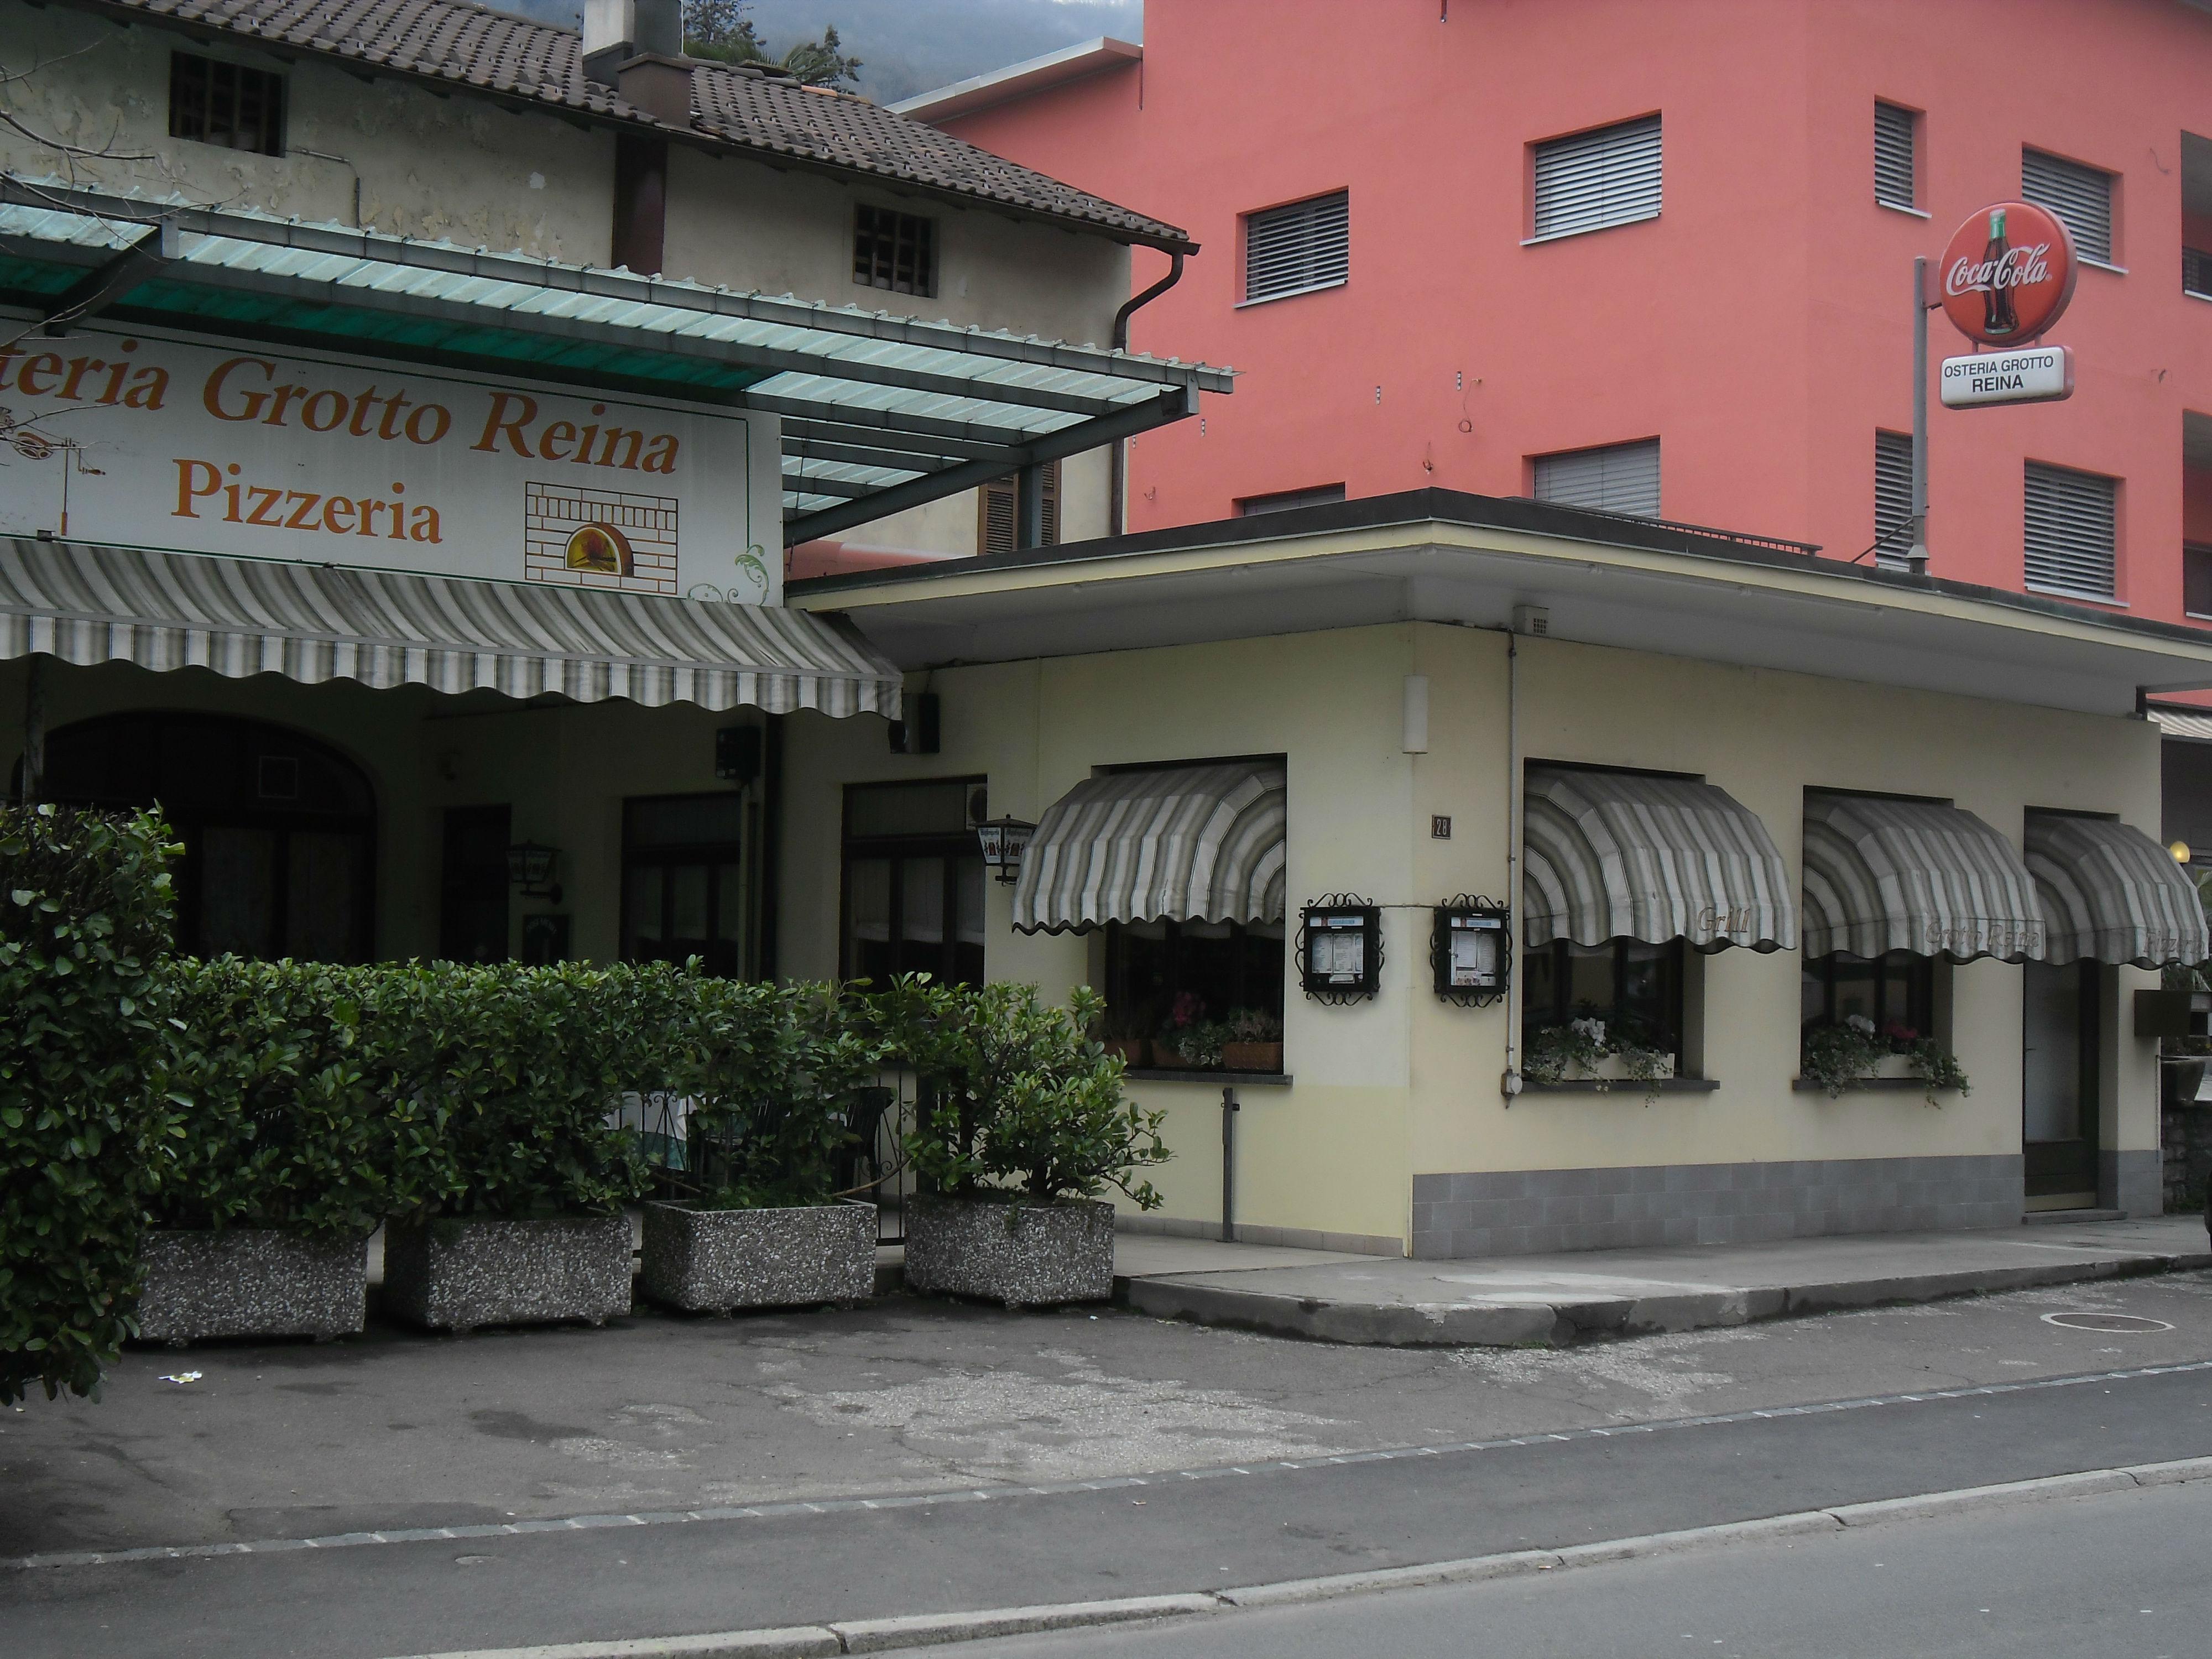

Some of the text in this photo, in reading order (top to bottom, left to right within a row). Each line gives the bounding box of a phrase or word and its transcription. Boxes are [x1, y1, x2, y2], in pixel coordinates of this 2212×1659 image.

[1946, 243, 2051, 296] Coca-Cola
[1944, 356, 2054, 378] OSTERIA GROTTO
[1972, 374, 2024, 393] REINA
[203, 357, 451, 445] Grotto
[470, 391, 680, 474] Reina
[171, 458, 443, 544] Pizzeria
[1436, 818, 1447, 836] 28
[1698, 906, 1751, 932] Grill
[1987, 924, 2039, 947] Reina
